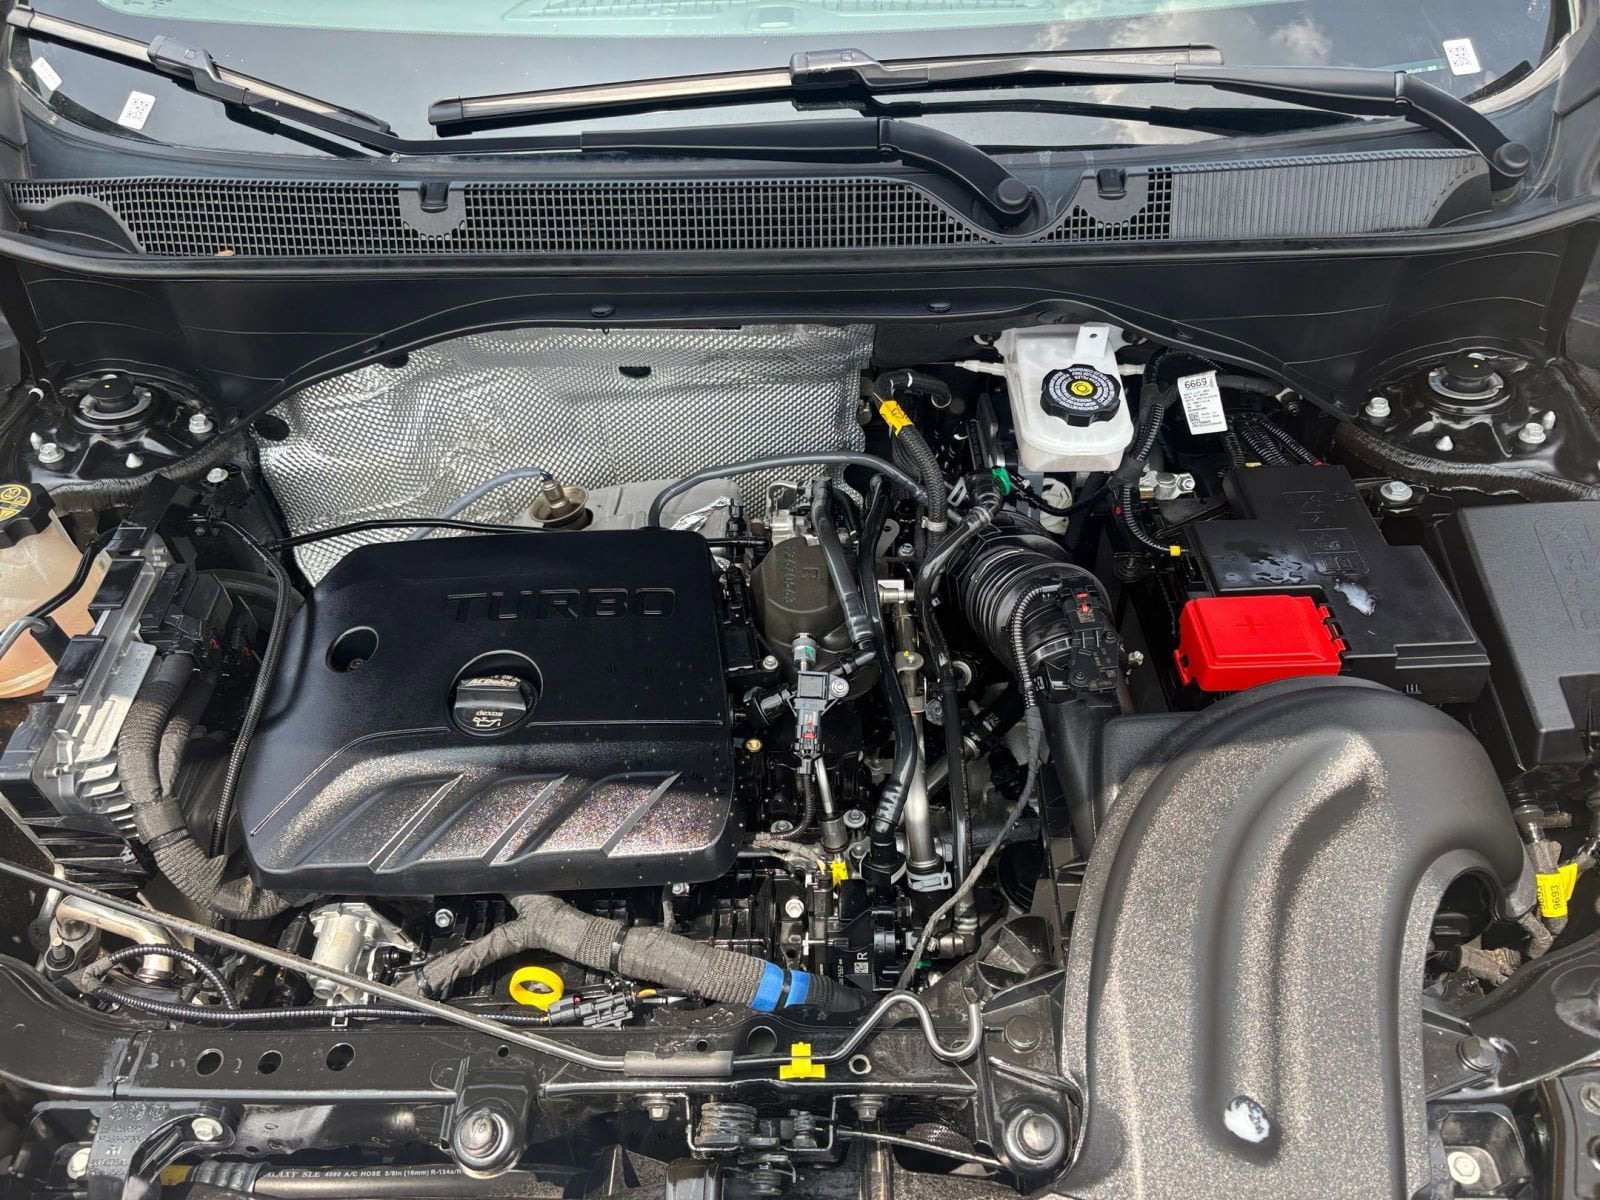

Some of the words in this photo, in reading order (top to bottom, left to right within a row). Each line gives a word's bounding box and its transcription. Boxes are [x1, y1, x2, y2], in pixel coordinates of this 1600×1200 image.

[1185, 378, 1207, 388] 6669
[448, 588, 675, 623] TURBO
[466, 677, 518, 687] ACDelco
[475, 709, 504, 717] dexos
[1551, 885, 1560, 910] 9693
[857, 952, 867, 960] R
[262, 1170, 300, 1178] ALAXY
